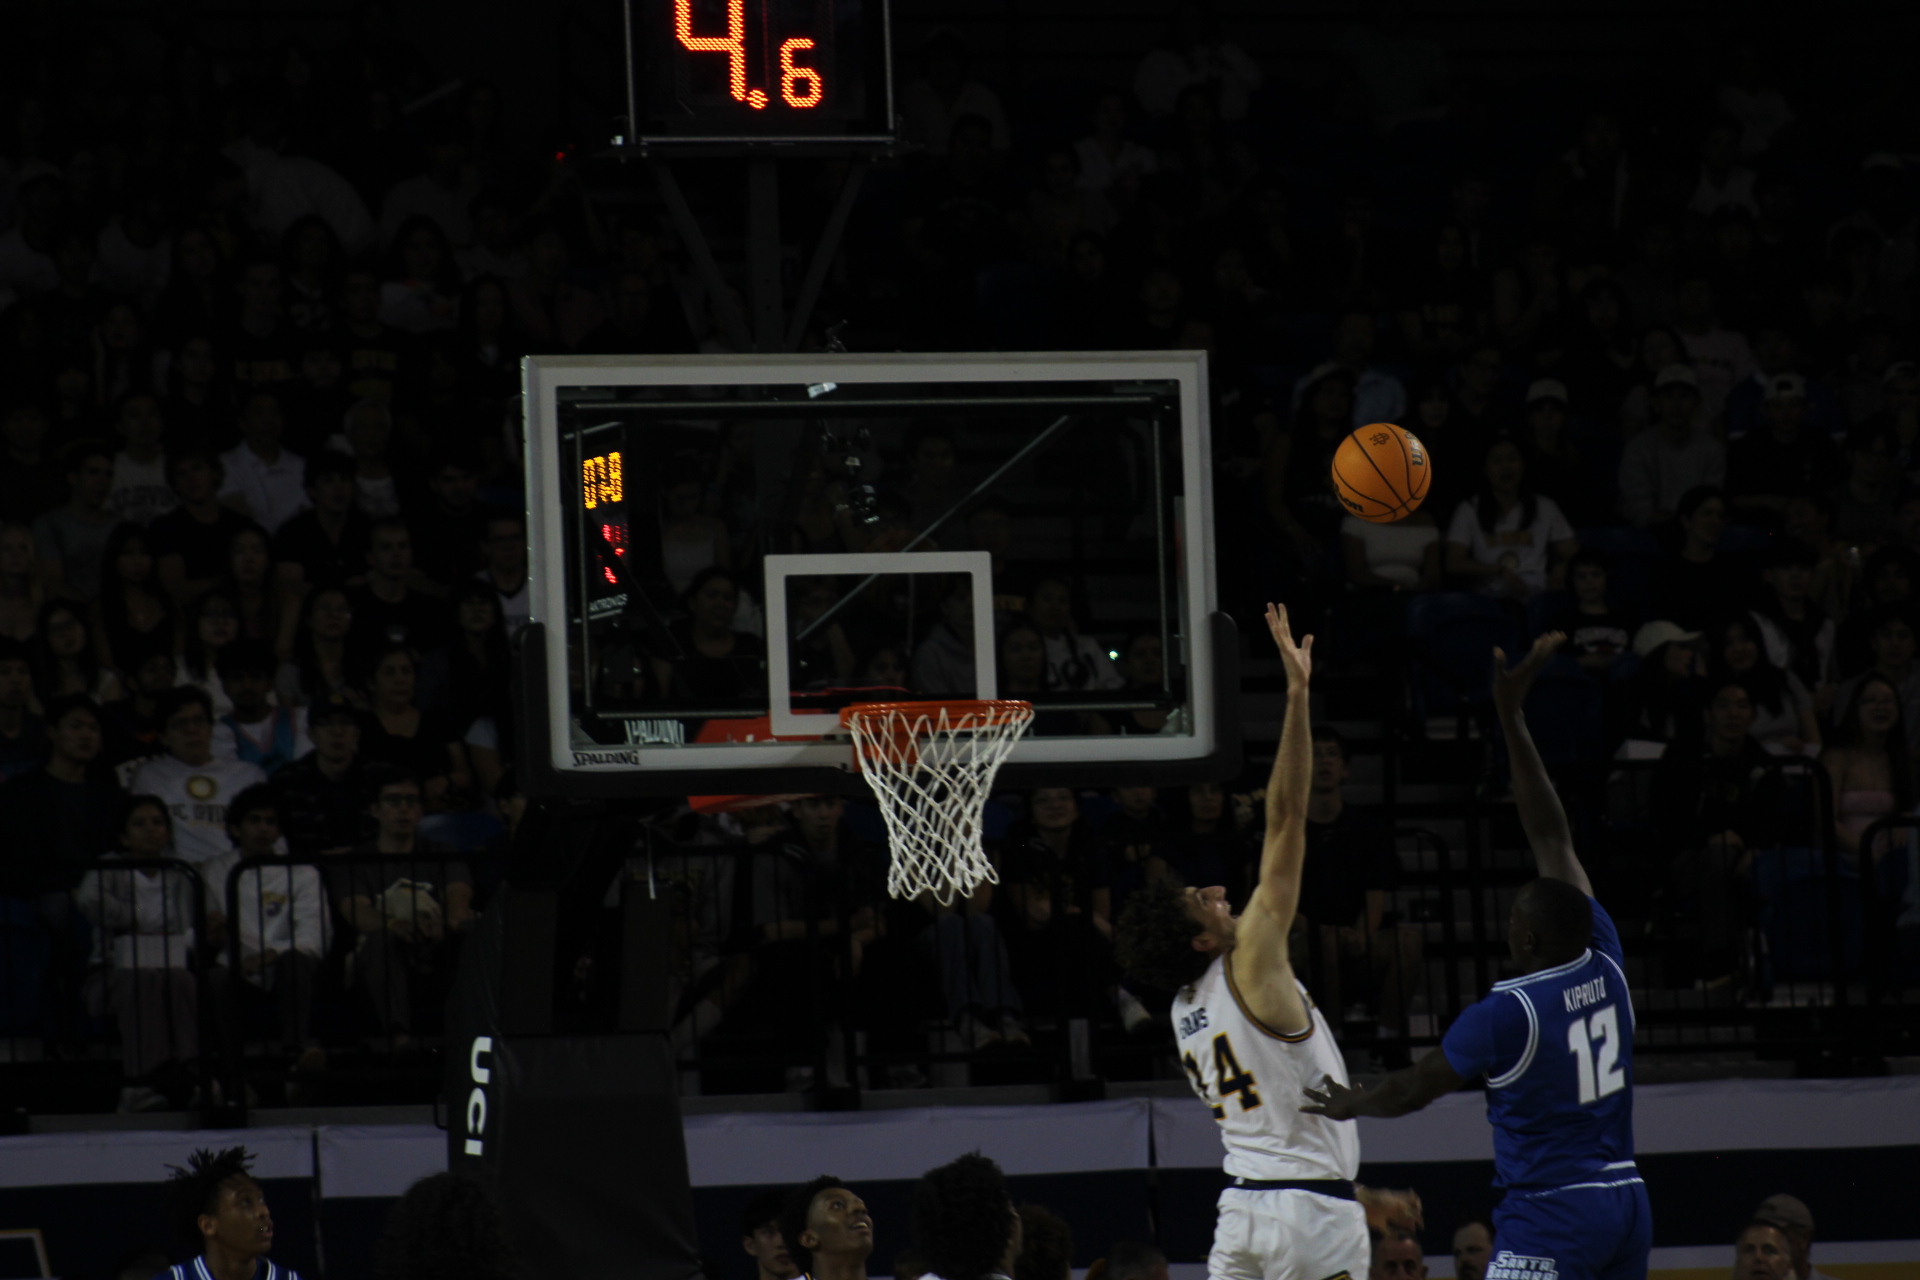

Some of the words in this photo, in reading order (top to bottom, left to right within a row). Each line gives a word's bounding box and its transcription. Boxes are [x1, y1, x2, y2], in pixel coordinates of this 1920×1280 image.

[572, 751, 640, 767] SPALDING
[1562, 975, 1607, 1013] KIPRUTO
[1567, 1003, 1626, 1106] 12
[464, 1035, 493, 1156] UCI
